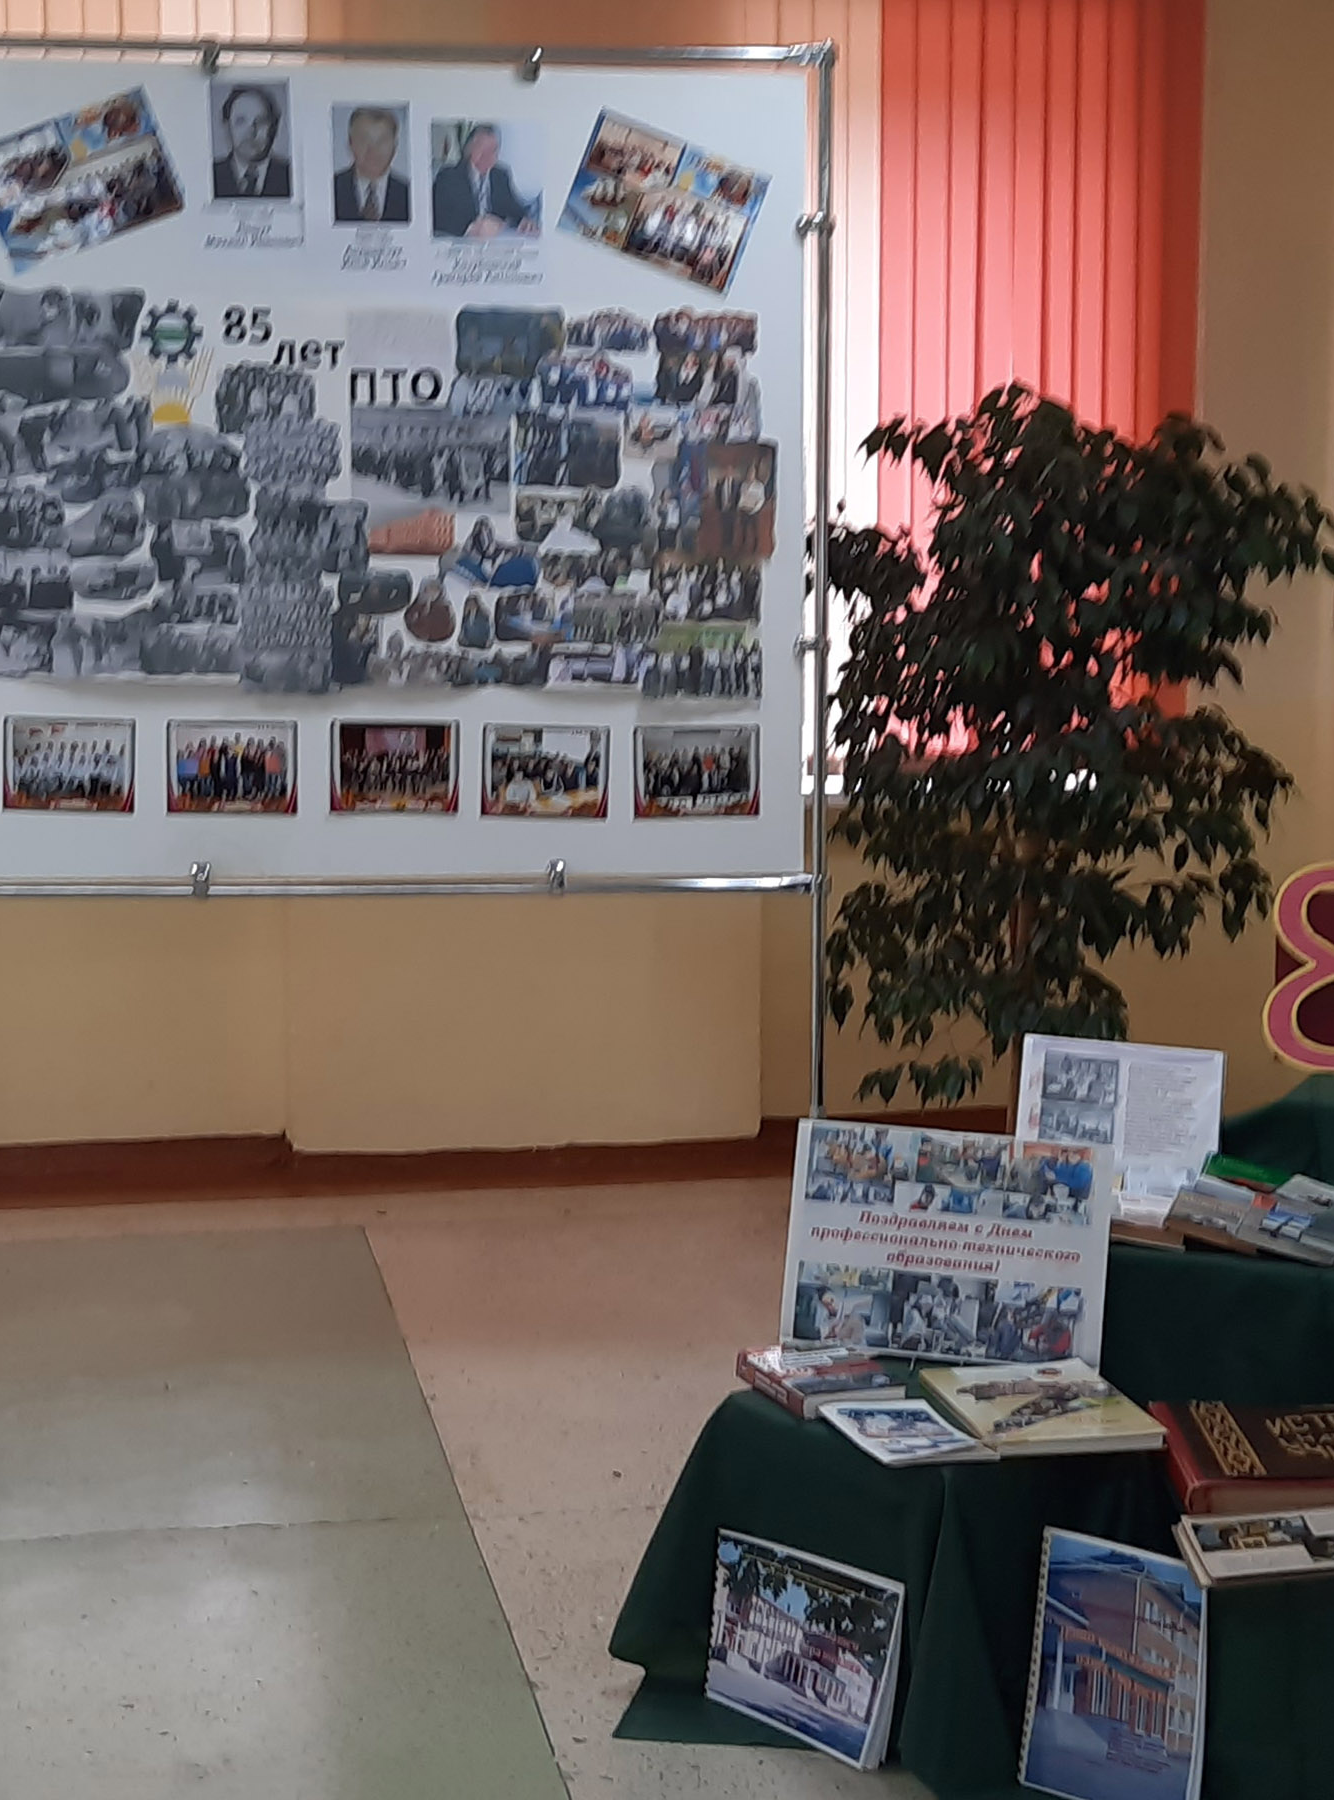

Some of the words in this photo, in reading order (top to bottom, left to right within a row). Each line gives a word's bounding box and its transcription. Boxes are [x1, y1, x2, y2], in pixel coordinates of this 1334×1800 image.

[221, 304, 274, 345] 85
[272, 339, 345, 370] лет
[350, 367, 444, 406] ПТО
[858, 1210, 969, 1235] Поздравляем
[974, 1224, 984, 1234] с
[985, 1221, 1034, 1240] Днем
